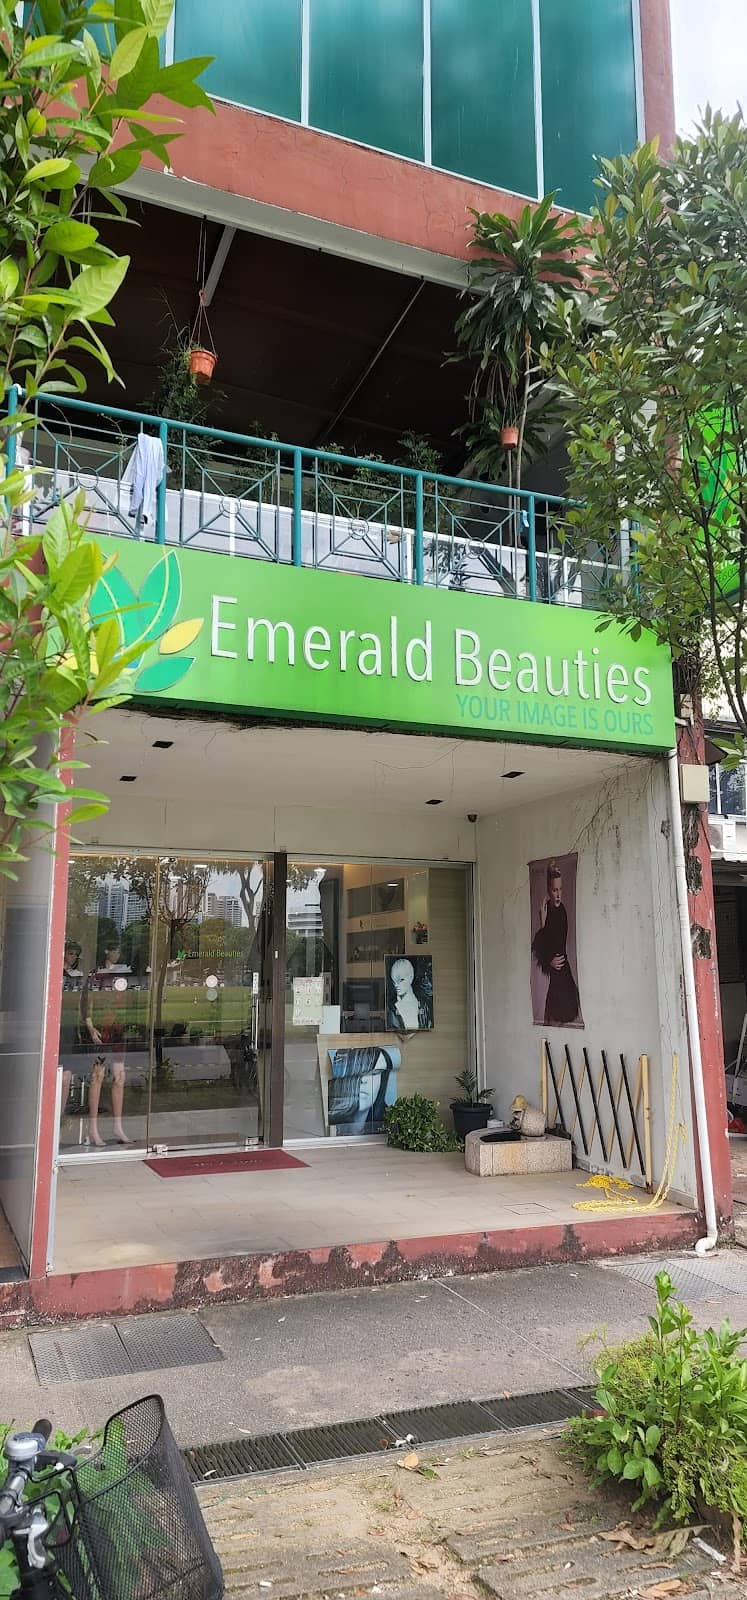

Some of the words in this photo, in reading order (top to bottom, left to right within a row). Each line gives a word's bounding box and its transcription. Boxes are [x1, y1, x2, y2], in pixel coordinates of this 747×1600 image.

[211, 594, 433, 682] Emerald
[455, 628, 651, 706] Beauties
[455, 693, 511, 721] YOUR
[516, 699, 577, 728] IMAGE
[583, 707, 599, 730] IS
[603, 709, 654, 736] OURS
